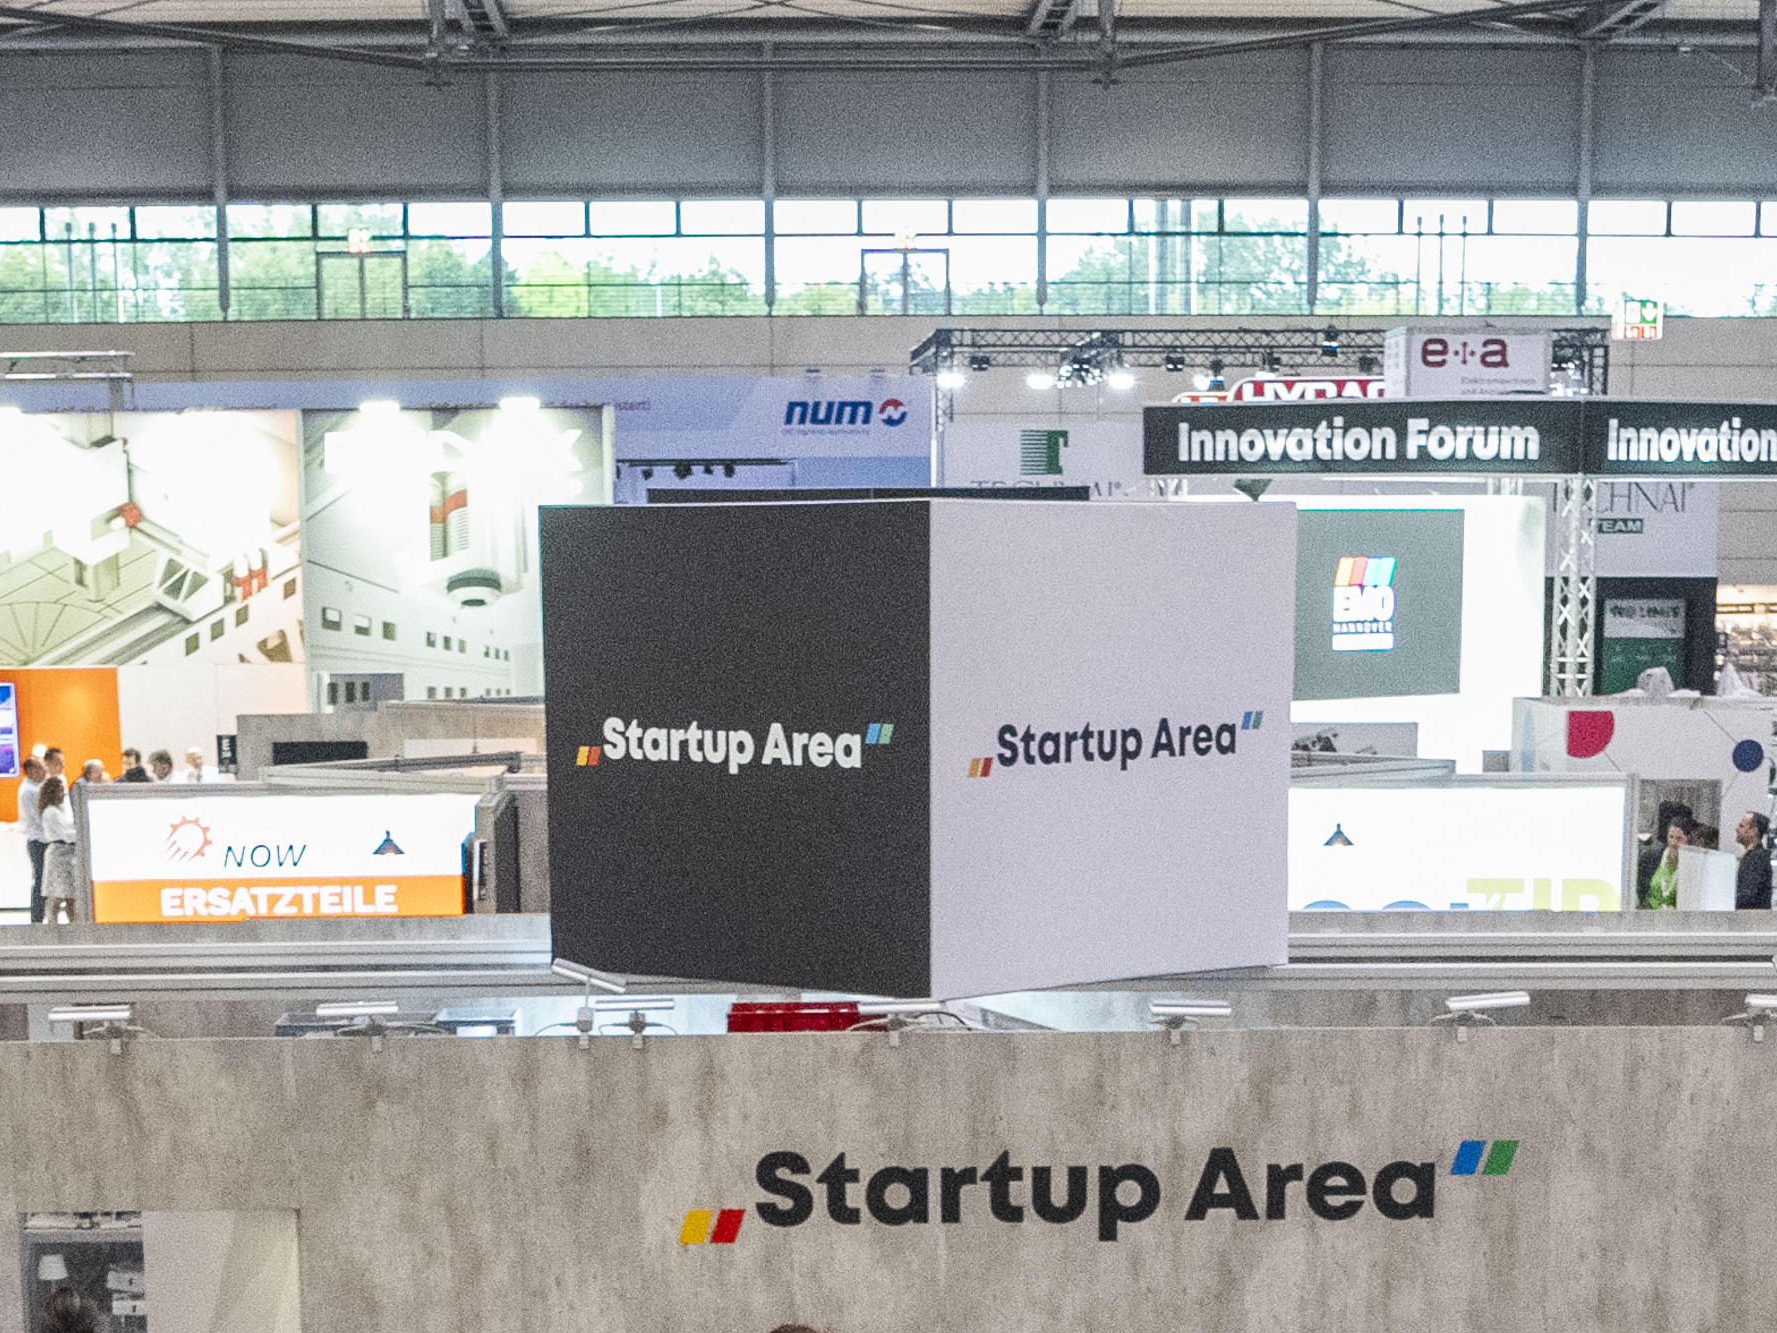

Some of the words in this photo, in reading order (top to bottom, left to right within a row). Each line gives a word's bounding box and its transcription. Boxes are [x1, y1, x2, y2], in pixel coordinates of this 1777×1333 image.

[784, 401, 872, 425] num
[1179, 418, 1396, 462] Innovation
[1407, 419, 1539, 461] Forum
[1333, 586, 1395, 621] EMO
[602, 717, 754, 774] Startup
[763, 722, 863, 768] Area
[997, 718, 1143, 771] Startup
[1151, 716, 1237, 760] Area
[223, 843, 307, 868] NOW
[161, 884, 397, 919] ERSATZTEILE
[754, 1148, 1161, 1241] Startup
[1185, 1146, 1436, 1223] Area
